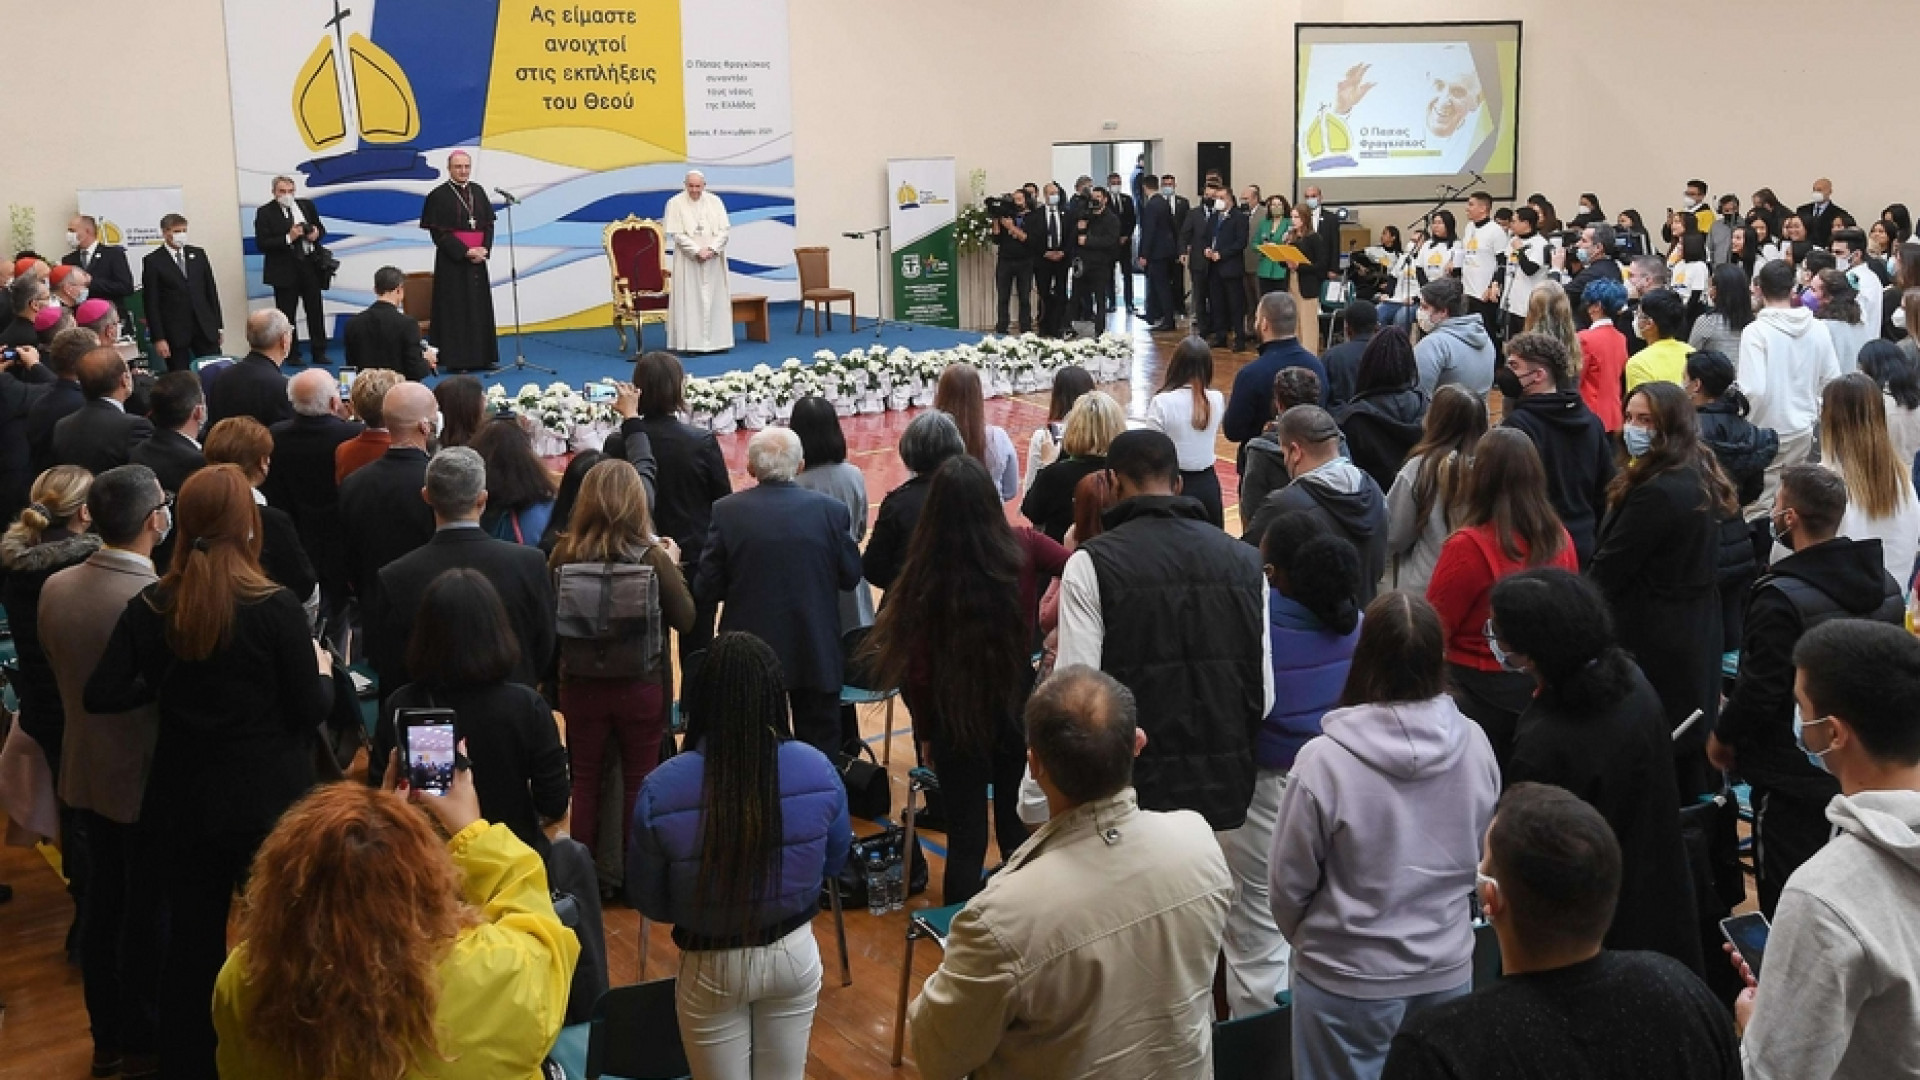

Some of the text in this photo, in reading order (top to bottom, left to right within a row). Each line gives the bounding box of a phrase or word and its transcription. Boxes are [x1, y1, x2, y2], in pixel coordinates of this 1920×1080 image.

[530, 5, 637, 27] Ας είμαστε
[544, 34, 627, 56] ανοιχτοί
[515, 63, 656, 85] στις εκπλήξεις
[542, 91, 635, 110] του Θεού
